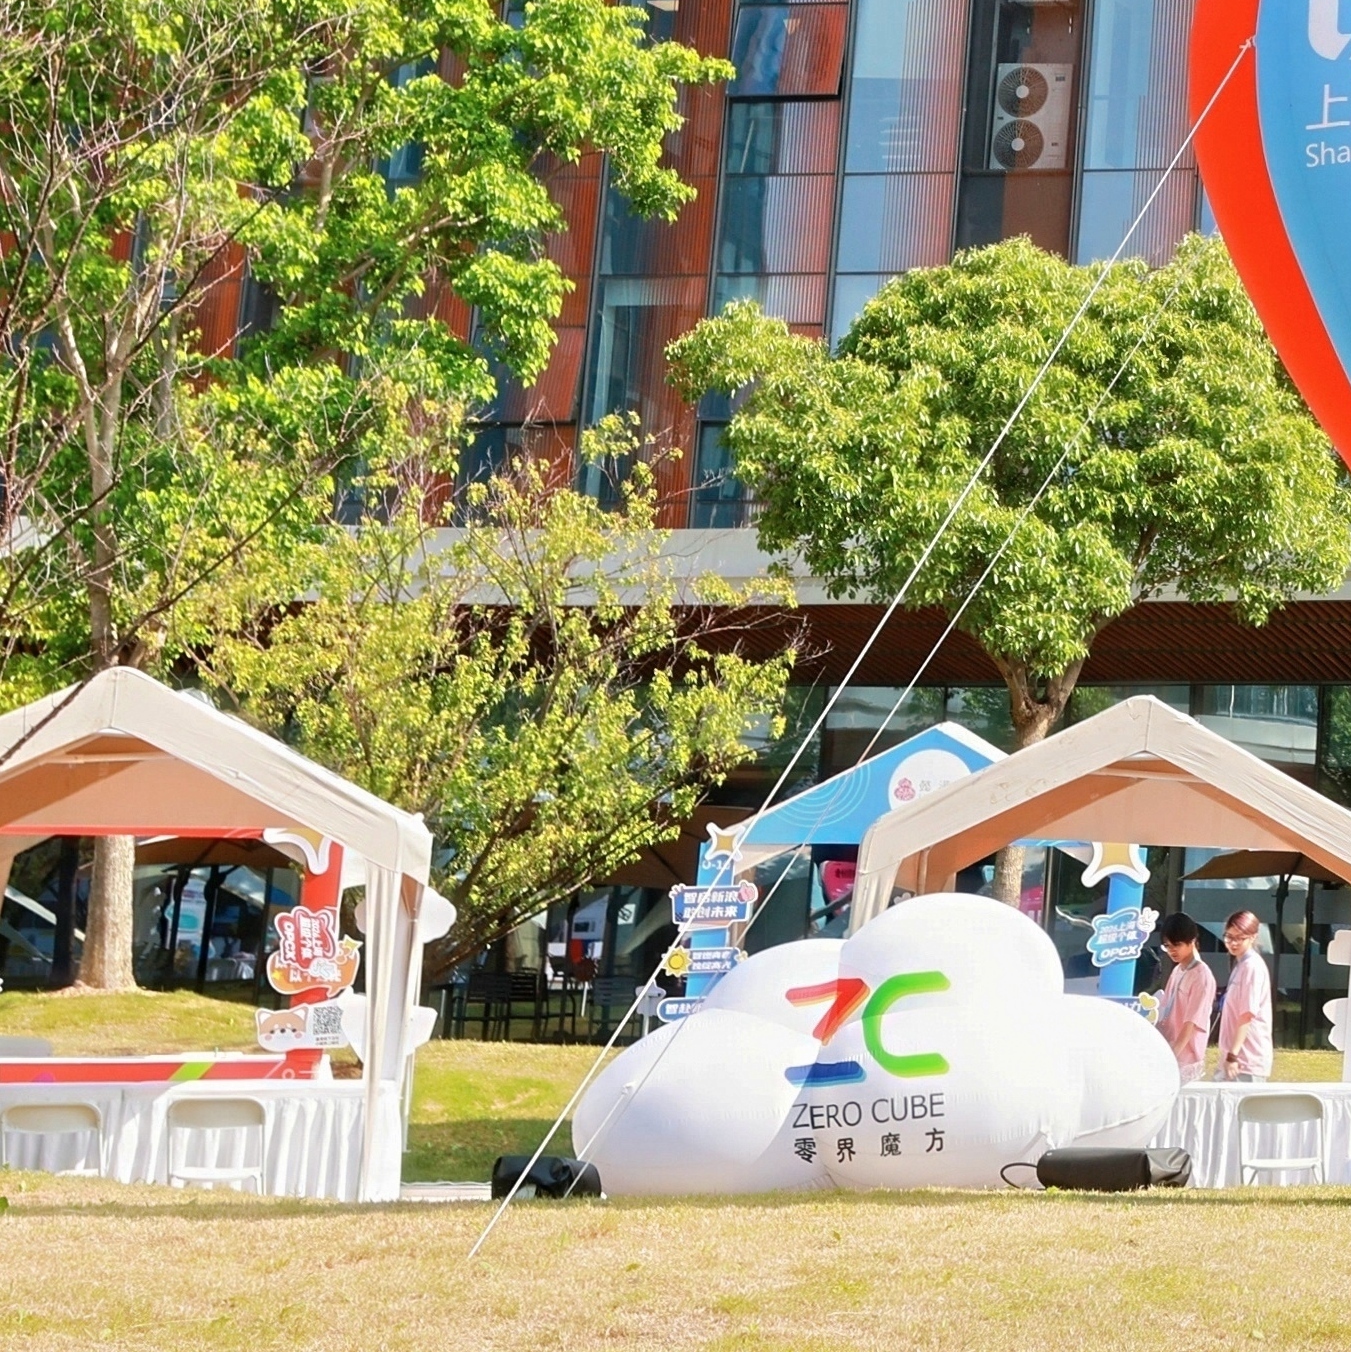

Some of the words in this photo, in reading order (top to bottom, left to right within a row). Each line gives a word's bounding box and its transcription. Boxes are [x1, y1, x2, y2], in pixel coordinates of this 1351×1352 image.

[284, 920, 296, 960] OPCX
[1101, 945, 1138, 959] OPCX
[792, 1101, 862, 1130] ZERO
[871, 1093, 945, 1123] CUBE
[794, 1128, 946, 1164] 零界魔方
